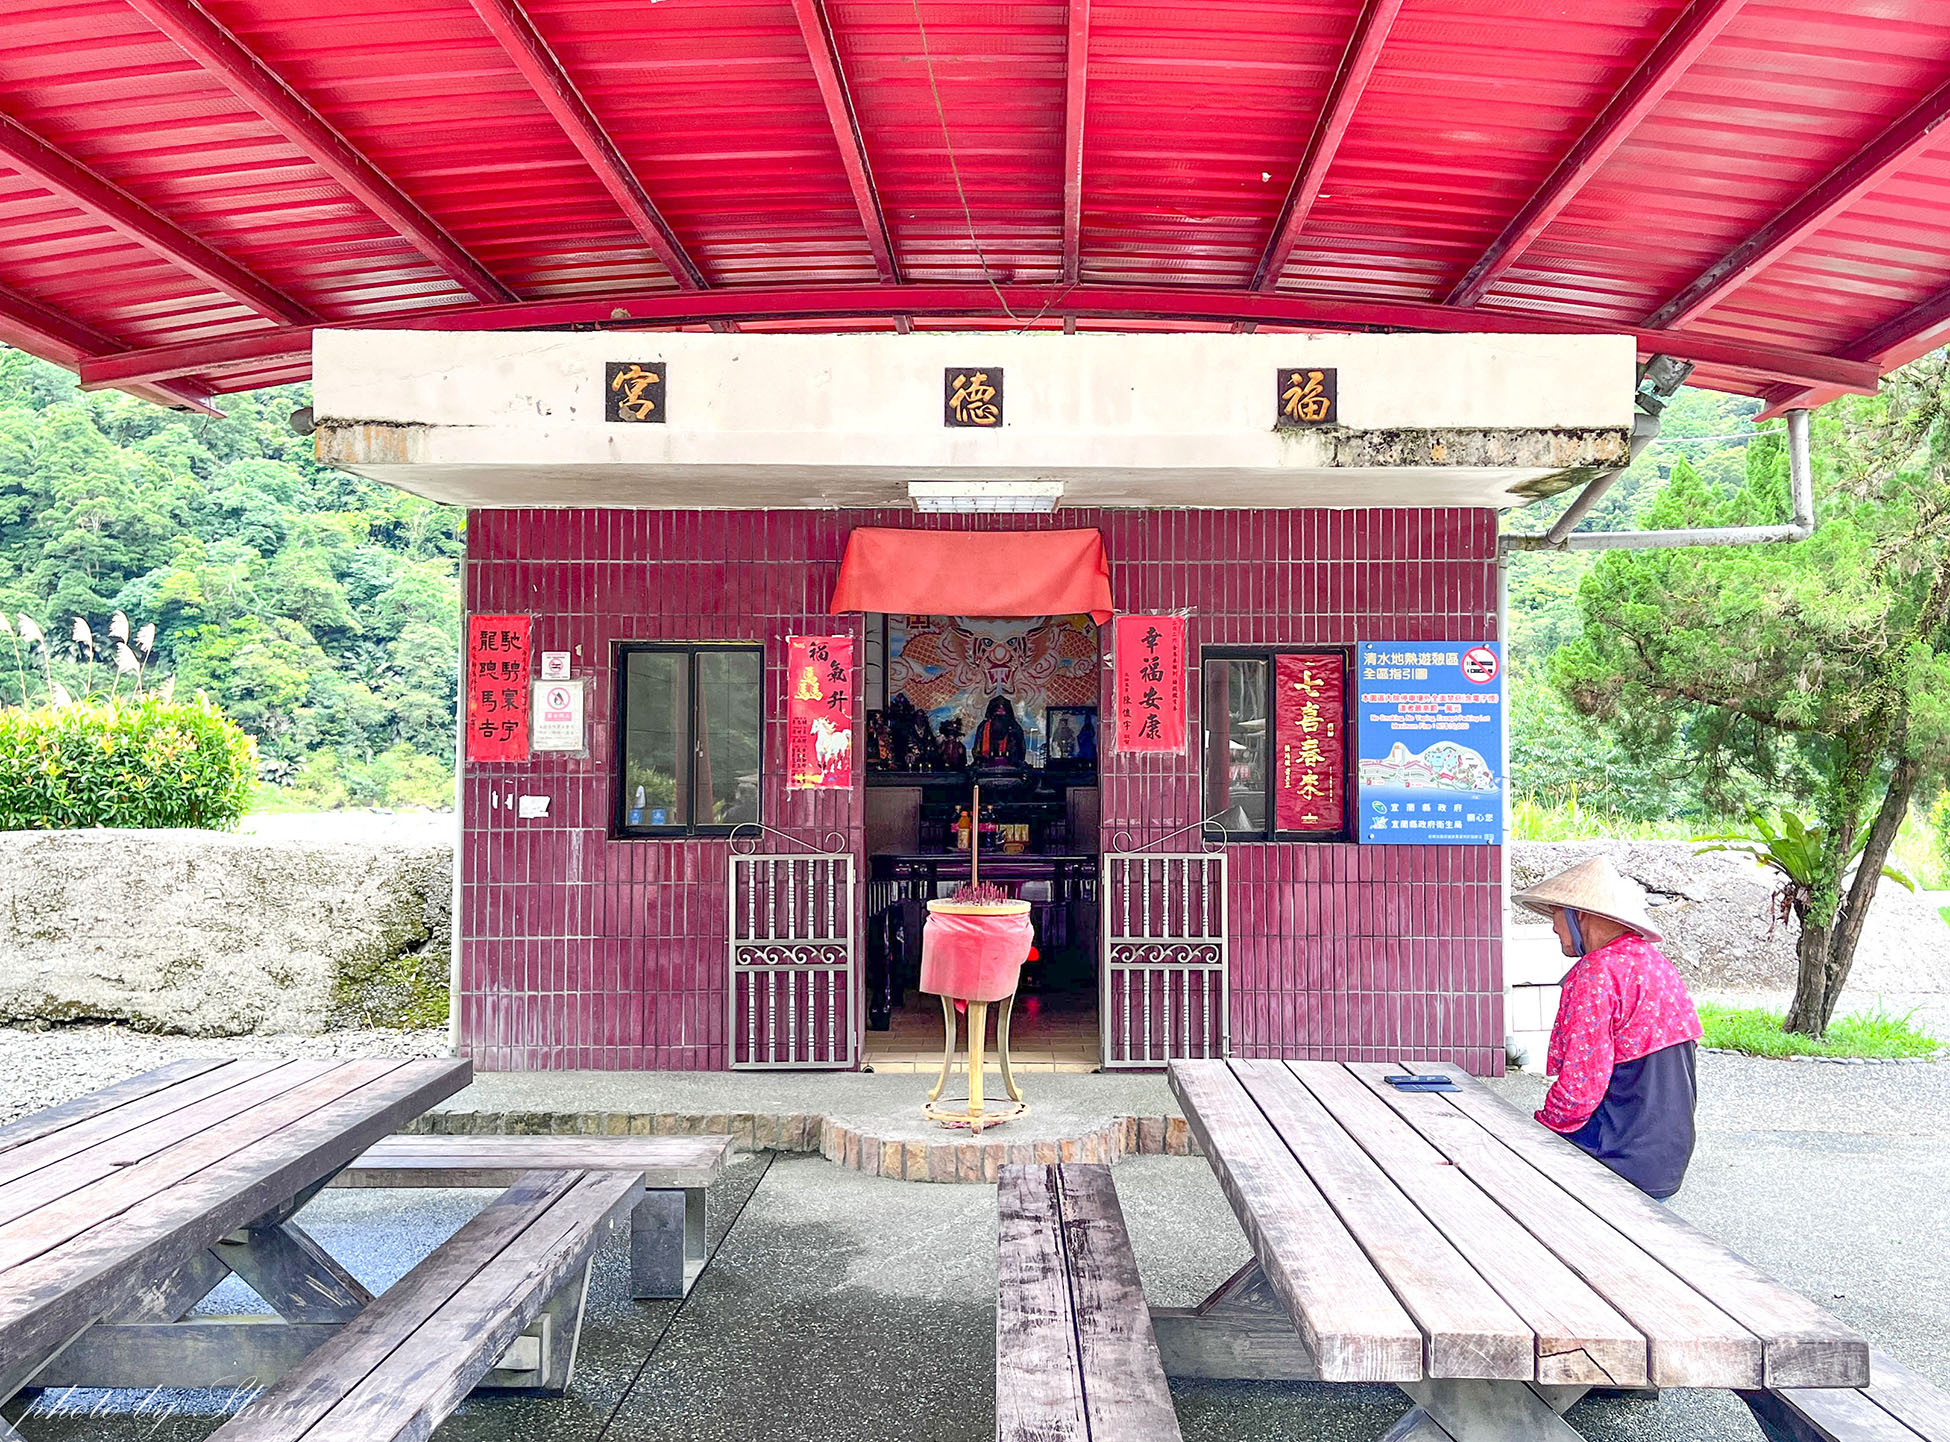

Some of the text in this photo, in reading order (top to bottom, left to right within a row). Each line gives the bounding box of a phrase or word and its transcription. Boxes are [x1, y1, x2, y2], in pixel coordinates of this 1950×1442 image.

[611, 365, 1331, 426] 福 德 宮
[1363, 652, 1459, 666] 清水地熱遊憩區
[1363, 667, 1428, 680] 全區指引圖
[1138, 626, 1165, 740] 幸福安康
